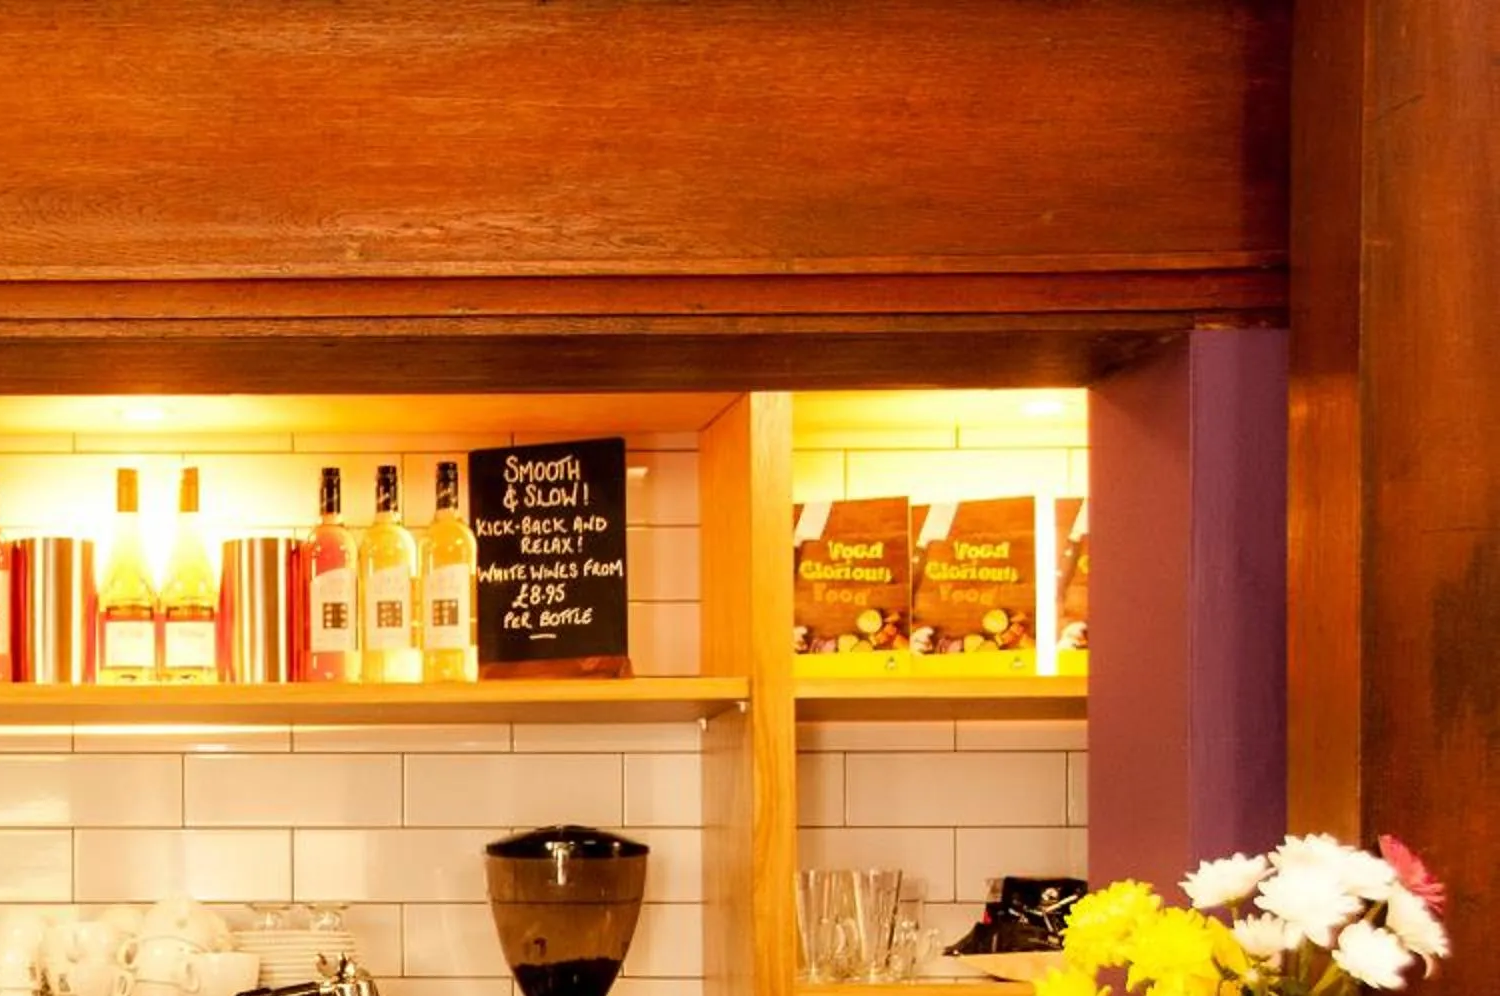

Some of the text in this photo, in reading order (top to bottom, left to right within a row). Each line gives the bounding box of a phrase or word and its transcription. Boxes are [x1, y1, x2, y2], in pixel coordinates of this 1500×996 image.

[503, 454, 581, 483] SMOOTH
[503, 483, 589, 513] & SLOW!
[475, 515, 608, 537] KICK-BACK AND
[477, 558, 624, 583] WHITE WINES FROM
[503, 607, 593, 629] PER BOTTLE
